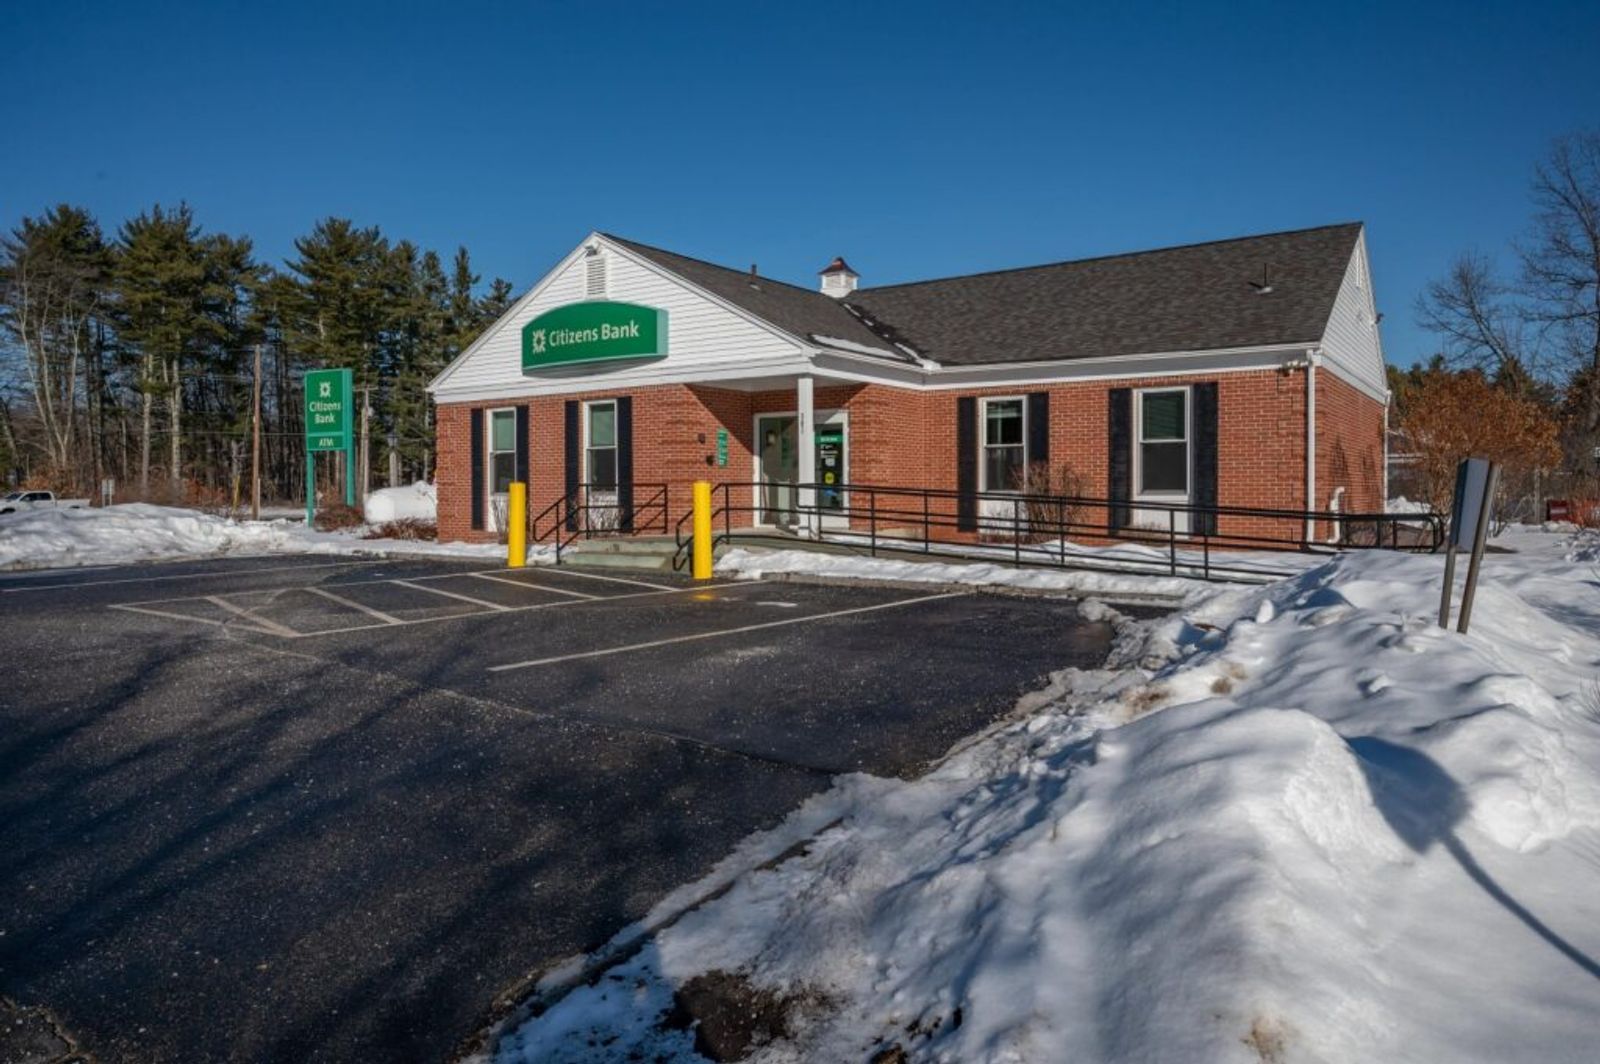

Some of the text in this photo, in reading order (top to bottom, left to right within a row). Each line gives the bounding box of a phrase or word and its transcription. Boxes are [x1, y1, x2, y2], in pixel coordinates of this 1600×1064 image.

[549, 319, 640, 347] Citizens Bank
[309, 401, 341, 412] Citizens
[315, 412, 336, 424] Bank
[319, 438, 334, 447] ATM
